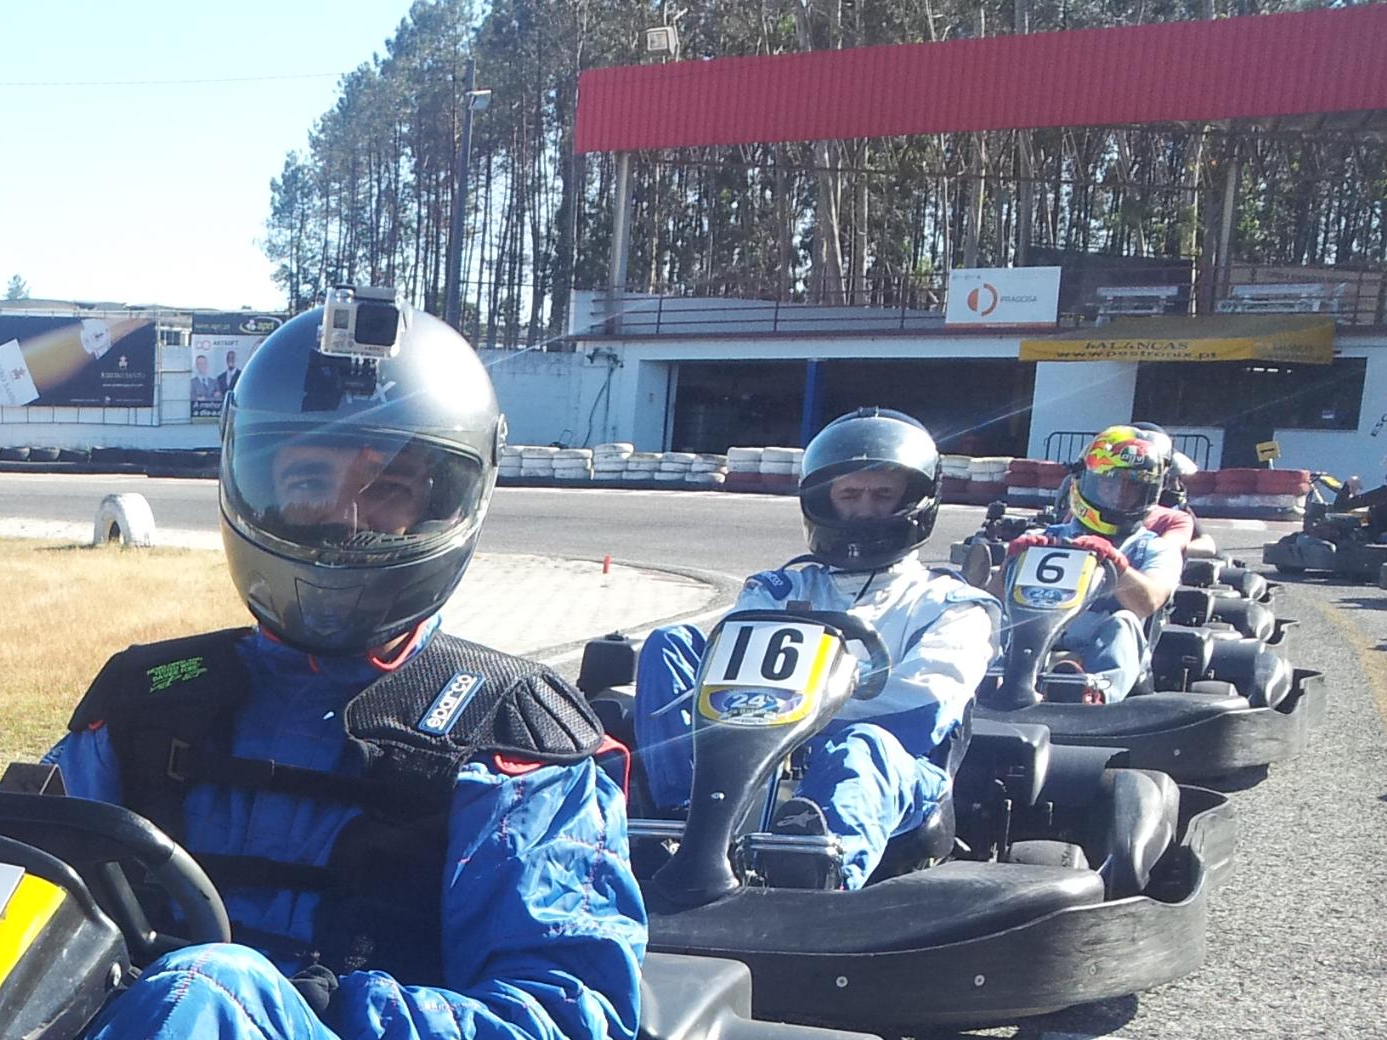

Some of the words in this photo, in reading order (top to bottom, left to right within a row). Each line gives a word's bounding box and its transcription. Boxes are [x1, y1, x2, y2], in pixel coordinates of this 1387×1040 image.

[1036, 552, 1070, 583] 6
[723, 625, 804, 681] 16
[426, 674, 473, 729] sparco
[730, 694, 769, 709] 24
